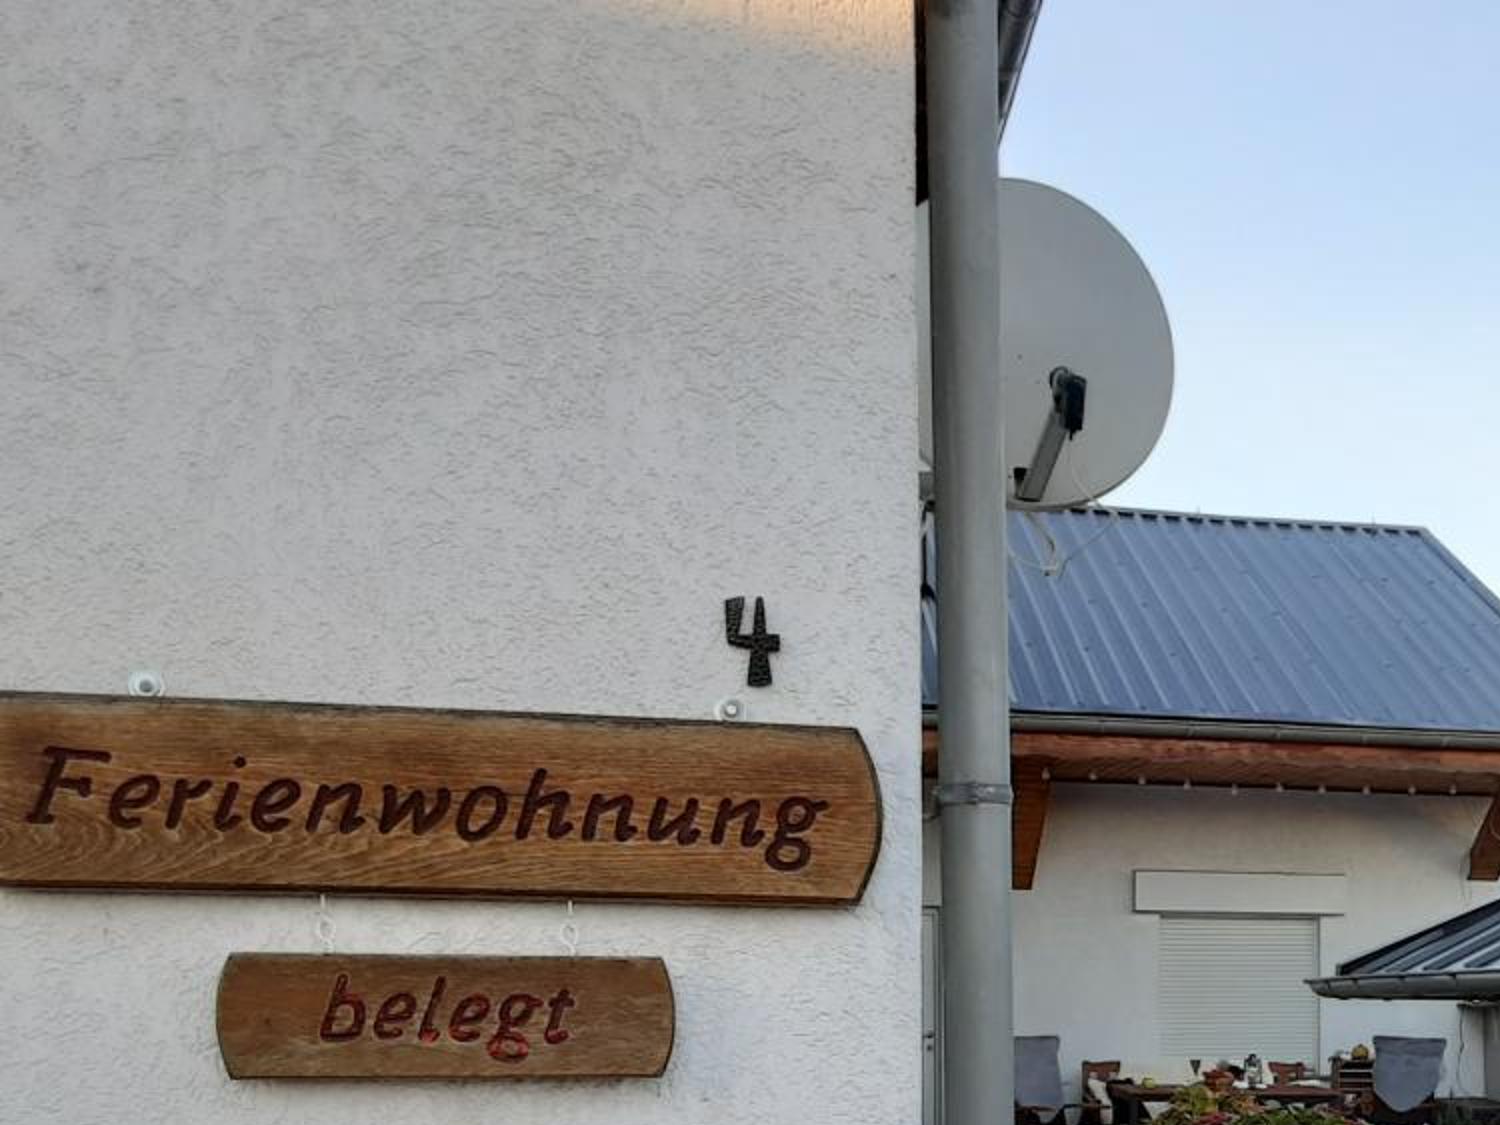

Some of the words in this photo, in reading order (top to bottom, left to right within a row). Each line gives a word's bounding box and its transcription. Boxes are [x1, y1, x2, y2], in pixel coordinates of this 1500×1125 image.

[724, 596, 781, 688] 4
[25, 745, 828, 872] Ferienwohnung
[319, 974, 576, 1063] belegt
